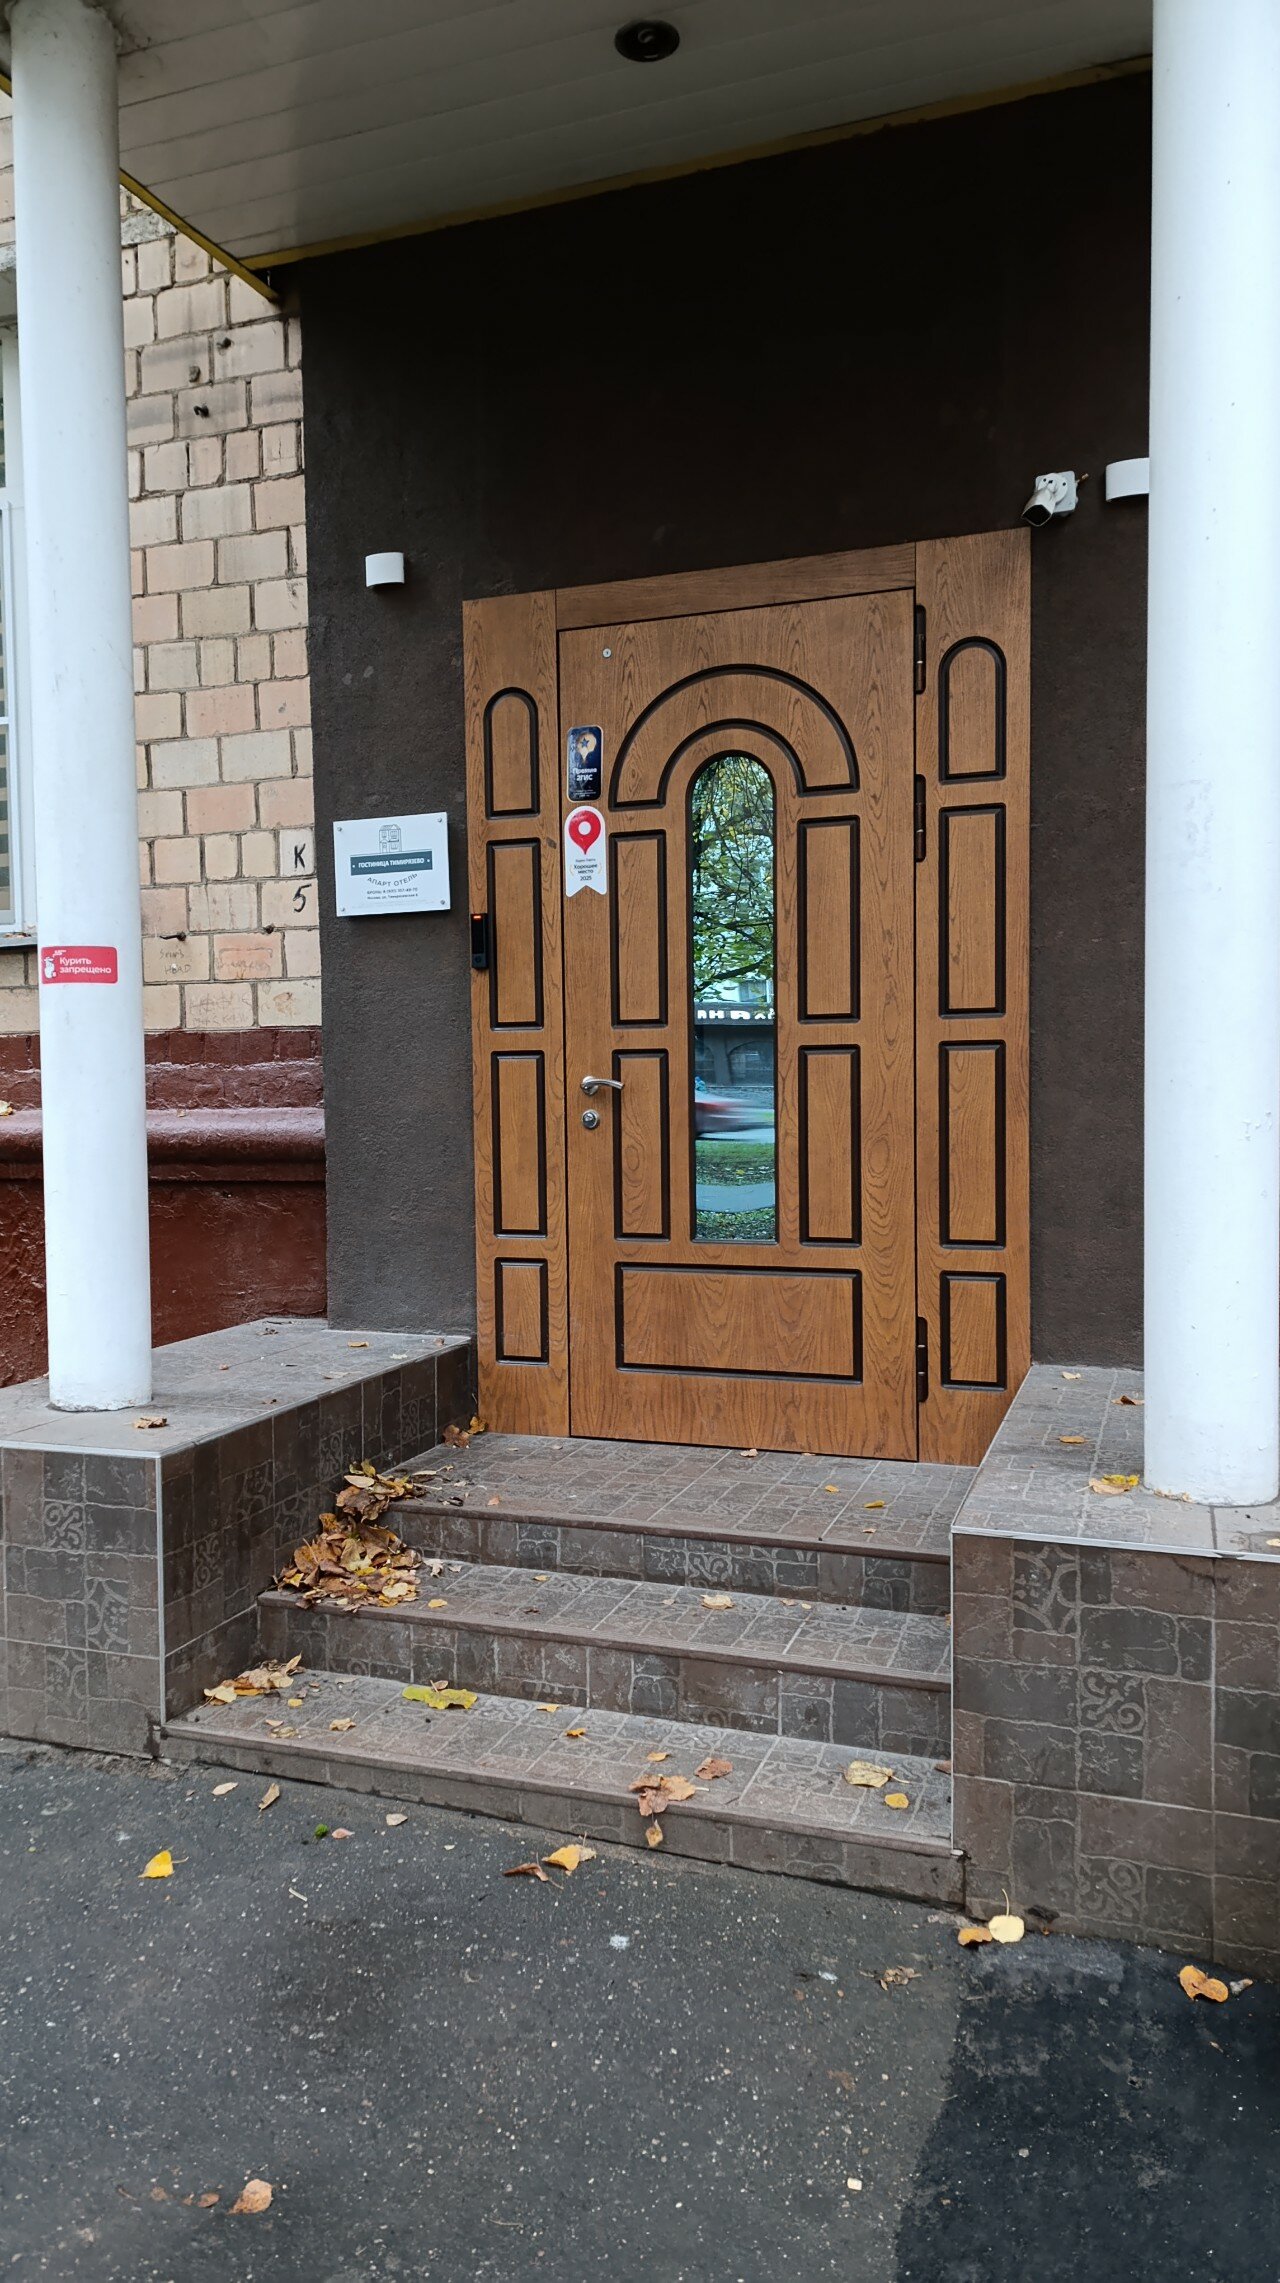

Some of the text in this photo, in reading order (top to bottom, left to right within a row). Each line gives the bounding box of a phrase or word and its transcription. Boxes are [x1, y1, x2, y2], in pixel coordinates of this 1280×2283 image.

[358, 857, 425, 868] ГОСТИНИЦА ТИМИРЯЗЕВО
[366, 873, 418, 887] АПАРТ ОТЕЛЬ
[292, 883, 312, 913] 5
[59, 957, 92, 966] Курить
[59, 966, 112, 975] запрещено
